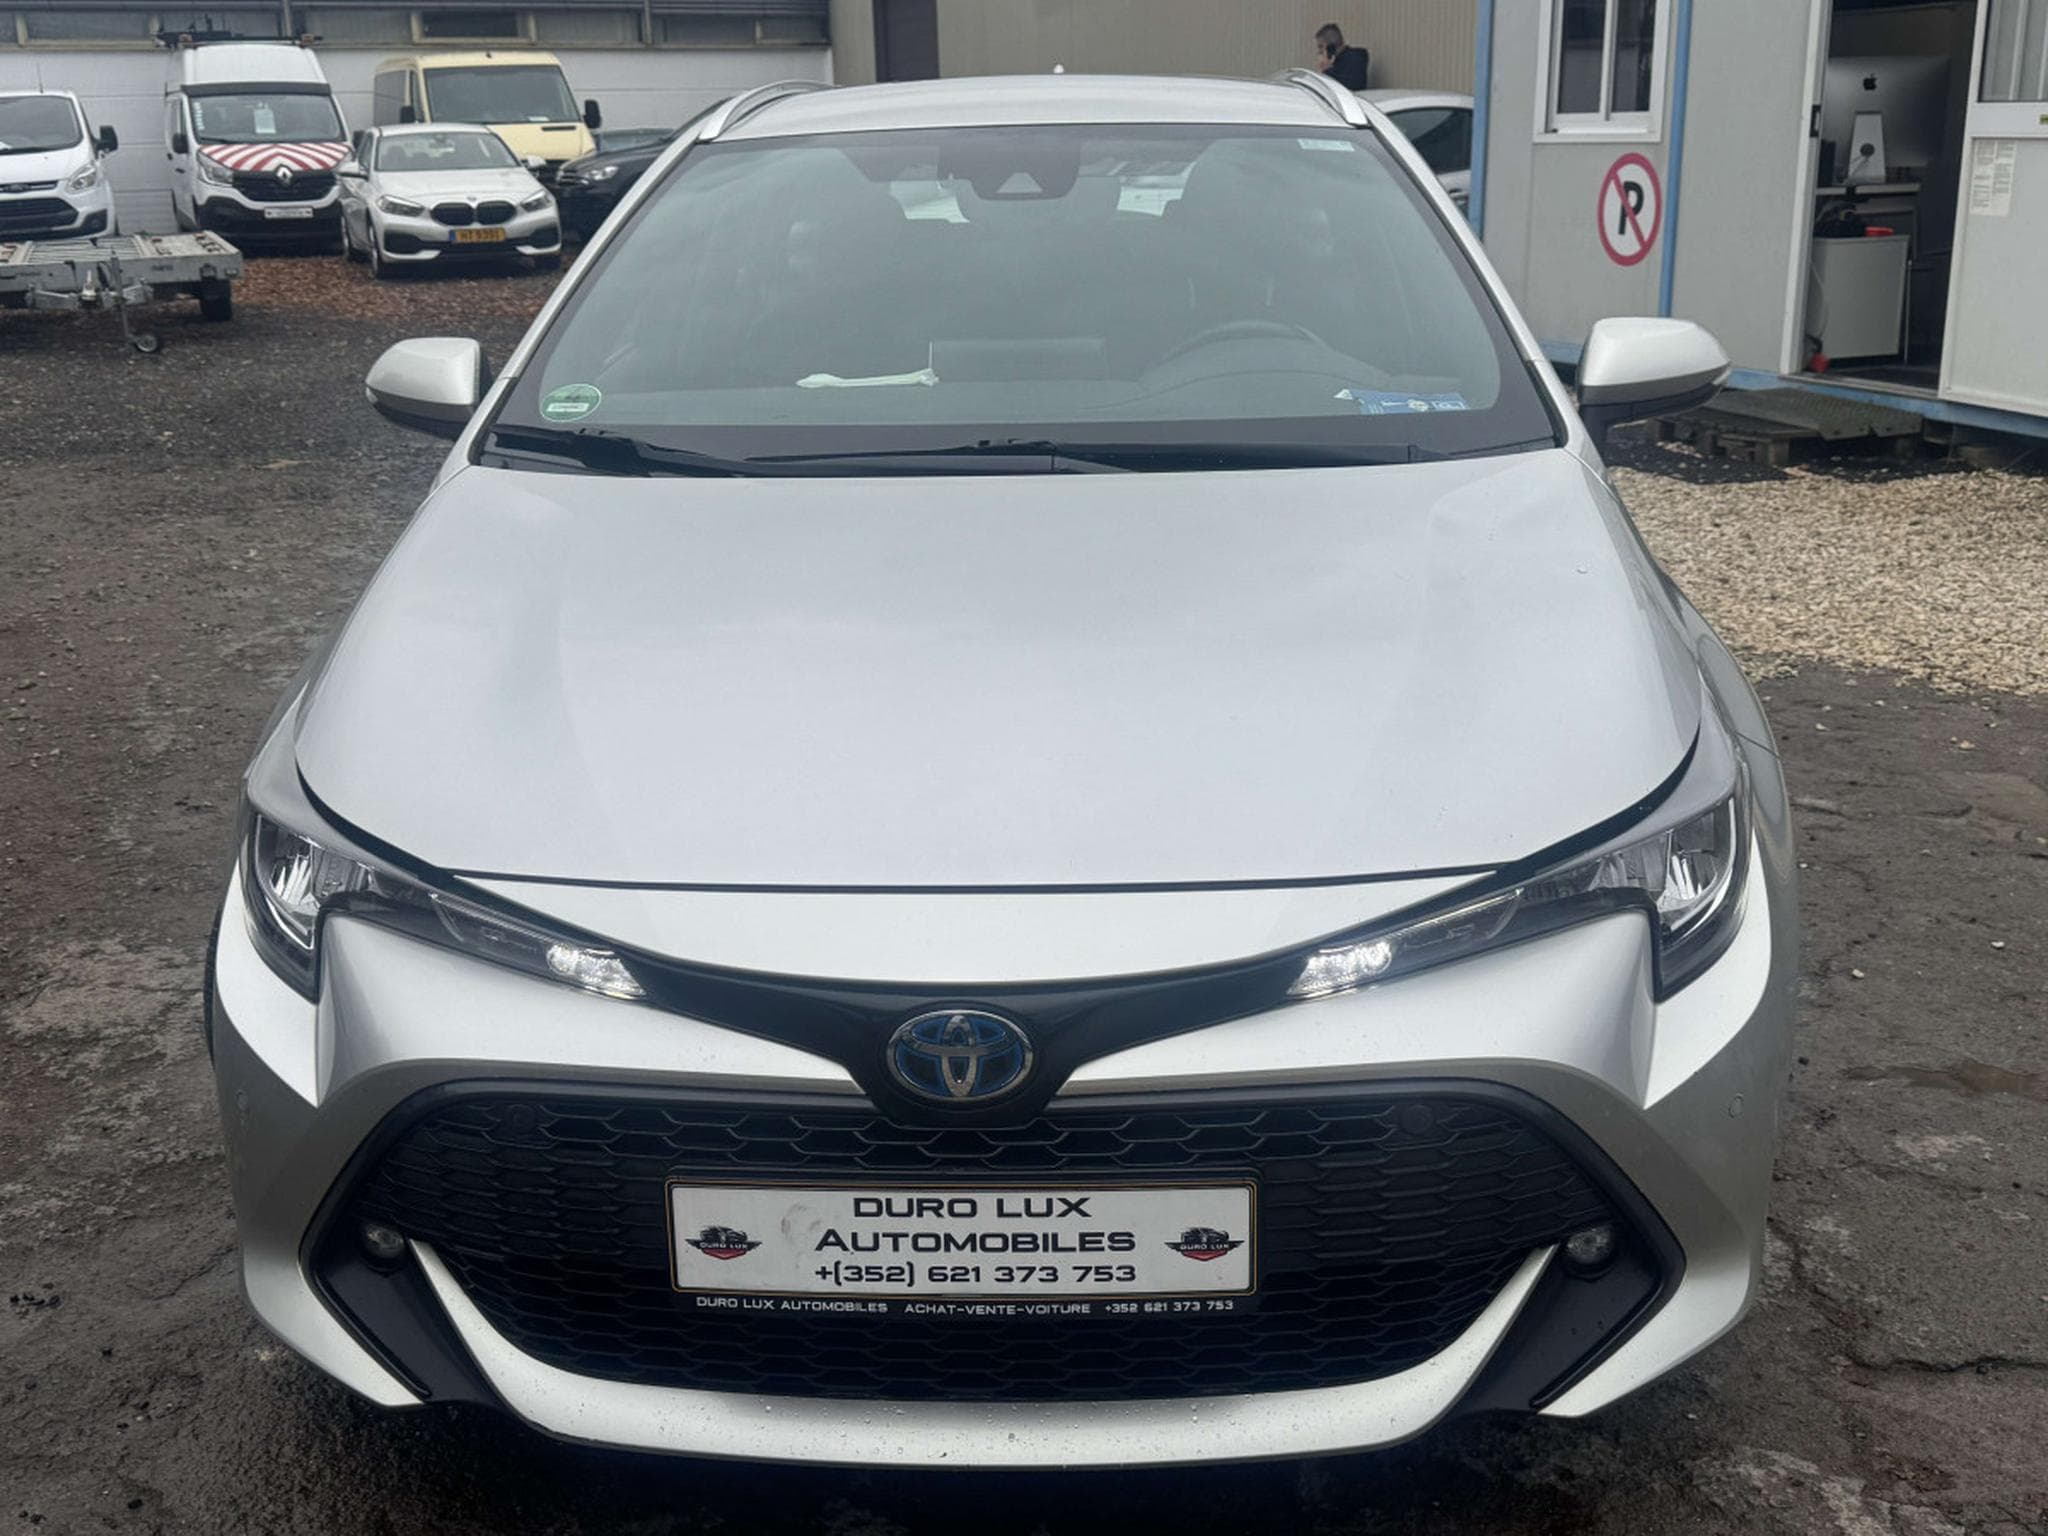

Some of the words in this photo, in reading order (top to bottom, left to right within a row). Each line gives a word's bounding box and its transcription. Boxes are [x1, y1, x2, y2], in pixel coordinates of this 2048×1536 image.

[1618, 181, 1644, 235] P
[853, 1197, 978, 1218] DURO
[996, 1197, 1092, 1218] LUX
[814, 1228, 1136, 1253] AUTOMOBILES
[815, 1260, 915, 1287] +(352)
[928, 1266, 981, 1282] 621
[994, 1266, 1059, 1282] 373
[1072, 1265, 1136, 1282] 753
[696, 1296, 738, 1308] DURO
[743, 1299, 775, 1310] LUX
[780, 1299, 889, 1314] AUTOMOBILES
[904, 1303, 1091, 1315] ACHAT-VENTE-VOITURE
[1105, 1303, 1138, 1313] +352
[1144, 1302, 1168, 1312] 621
[1173, 1301, 1201, 1312] 373
[1206, 1300, 1234, 1311] 753
